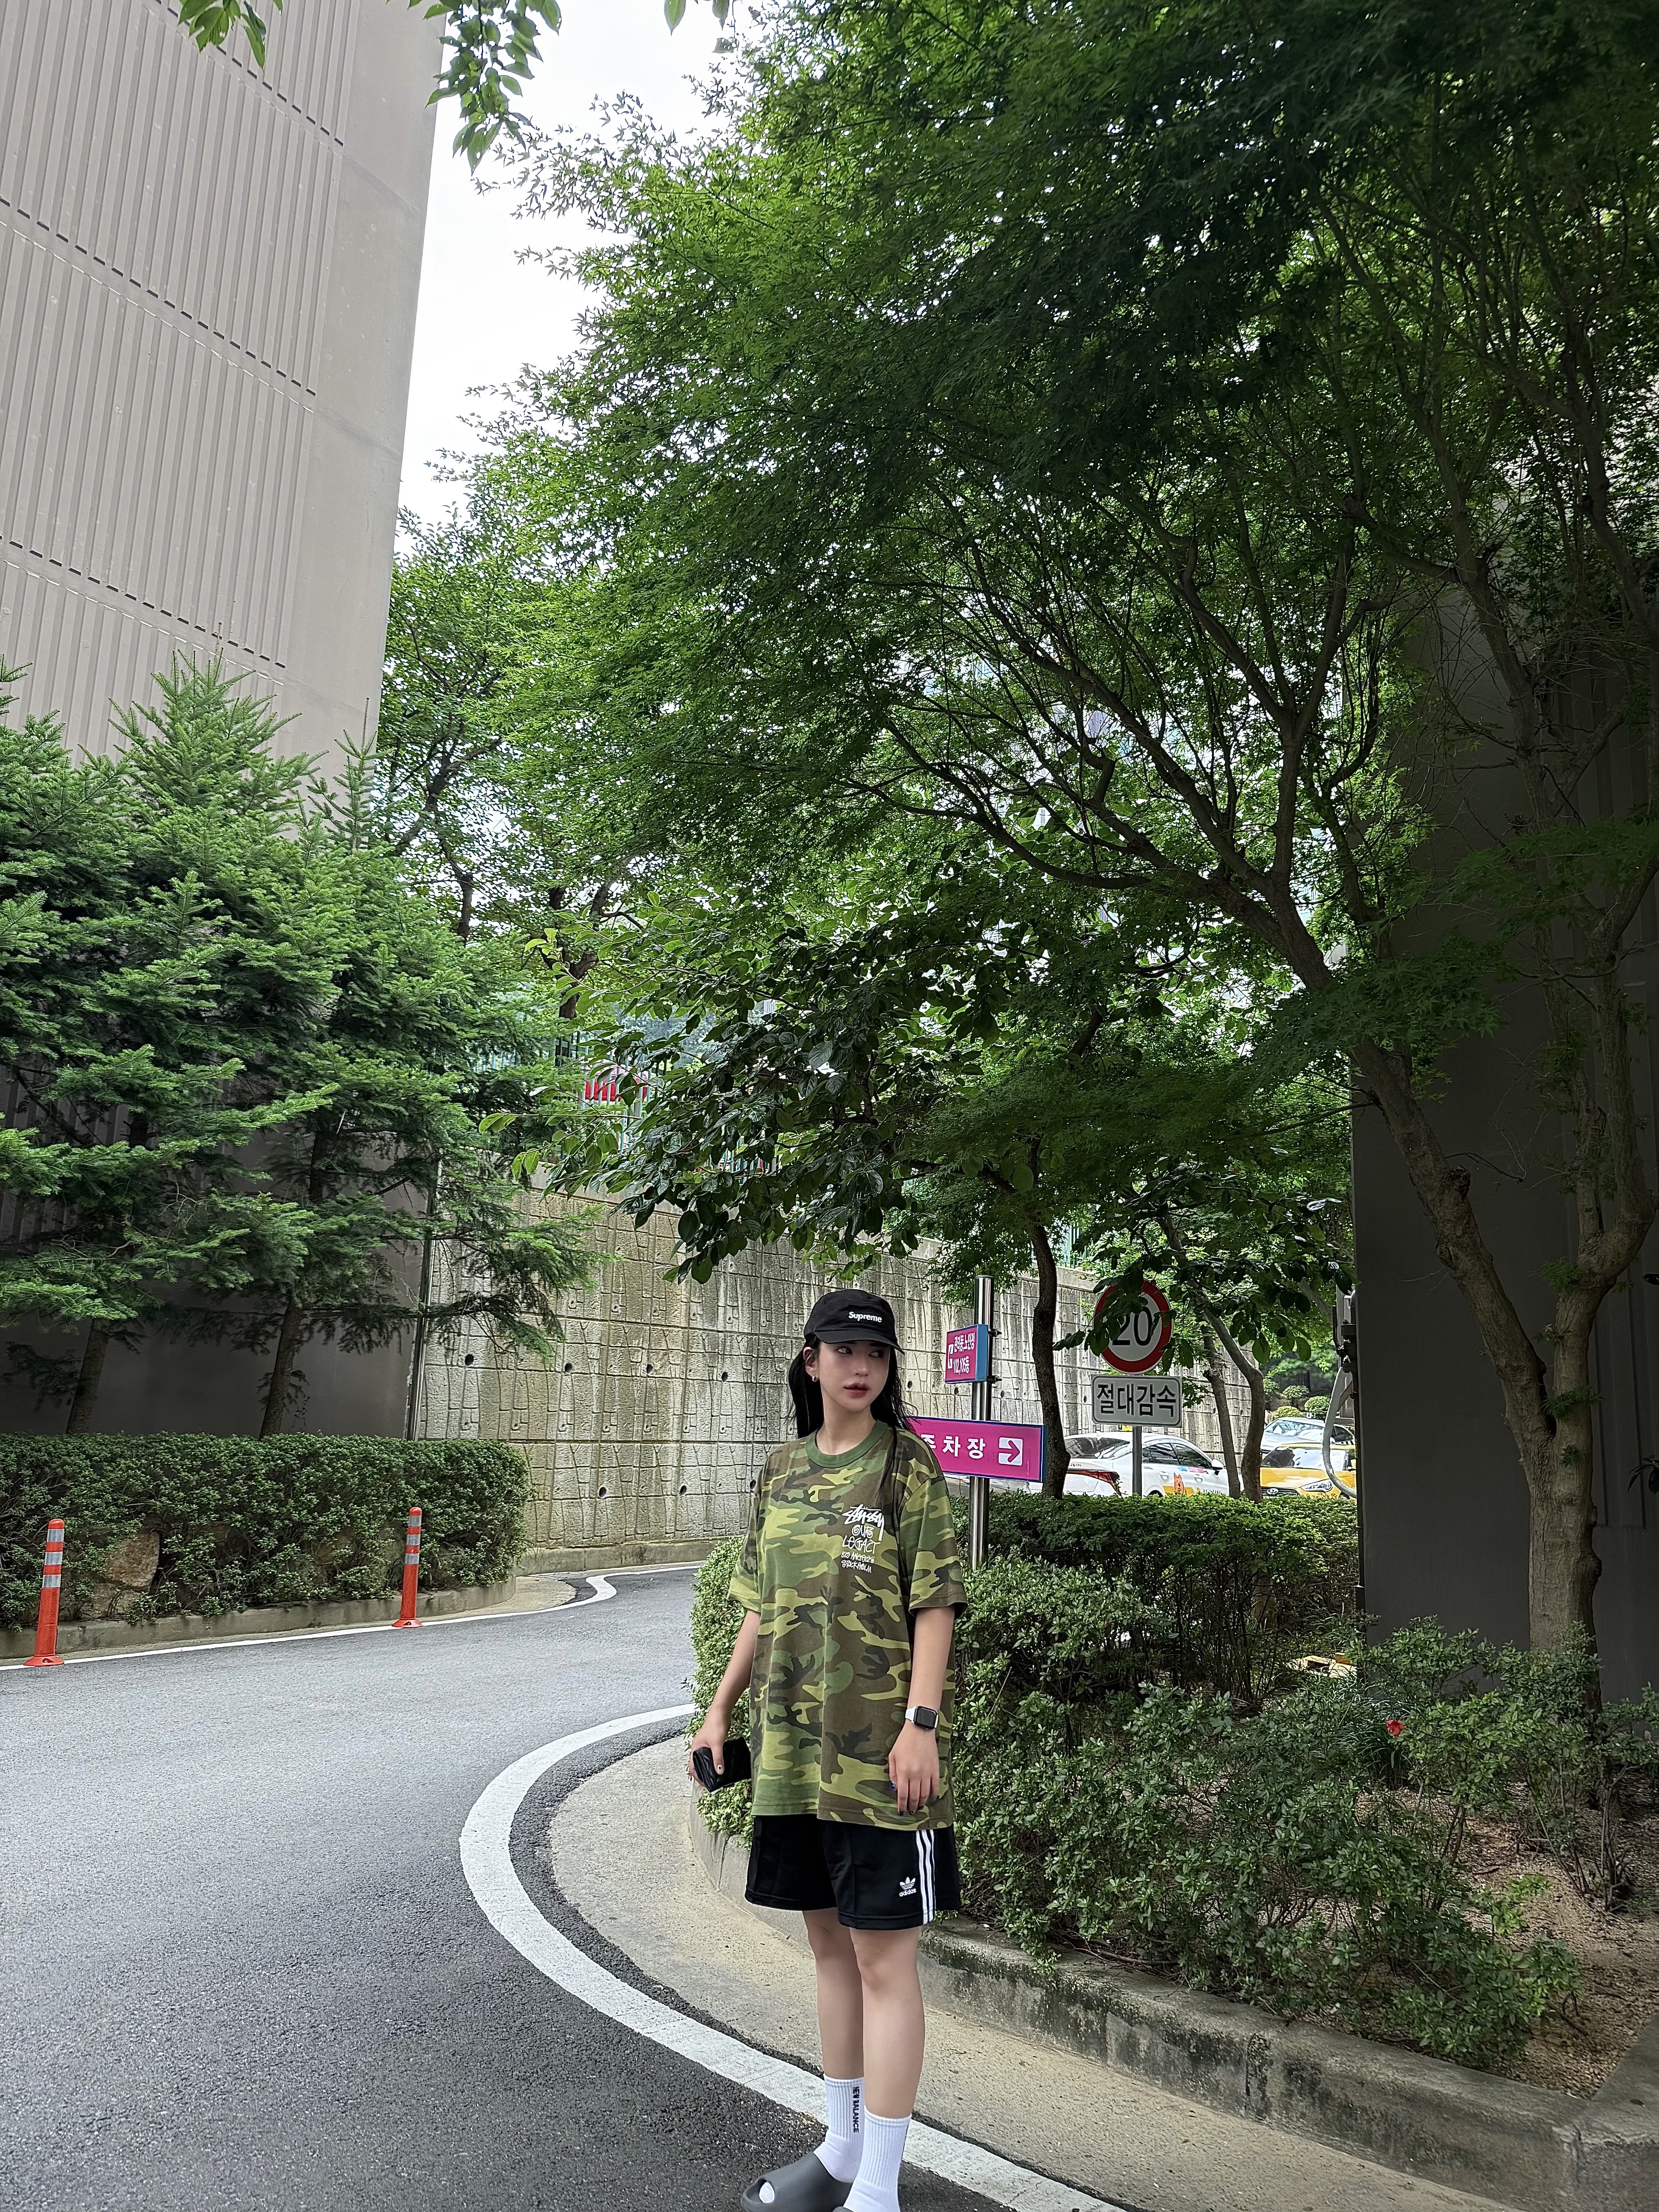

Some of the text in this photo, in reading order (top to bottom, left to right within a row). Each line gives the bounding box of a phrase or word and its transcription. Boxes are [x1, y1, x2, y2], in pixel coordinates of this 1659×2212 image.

[849, 1312, 882, 1322] Supreme
[1112, 1306, 1153, 1346] 20
[1097, 1383, 1176, 1417] 절대감속
[852, 1524, 874, 1539] OUR
[841, 1551, 850, 1559] LOS
[841, 1559, 872, 1573] STOCKHOLM
[899, 1888, 916, 1897] adidas
